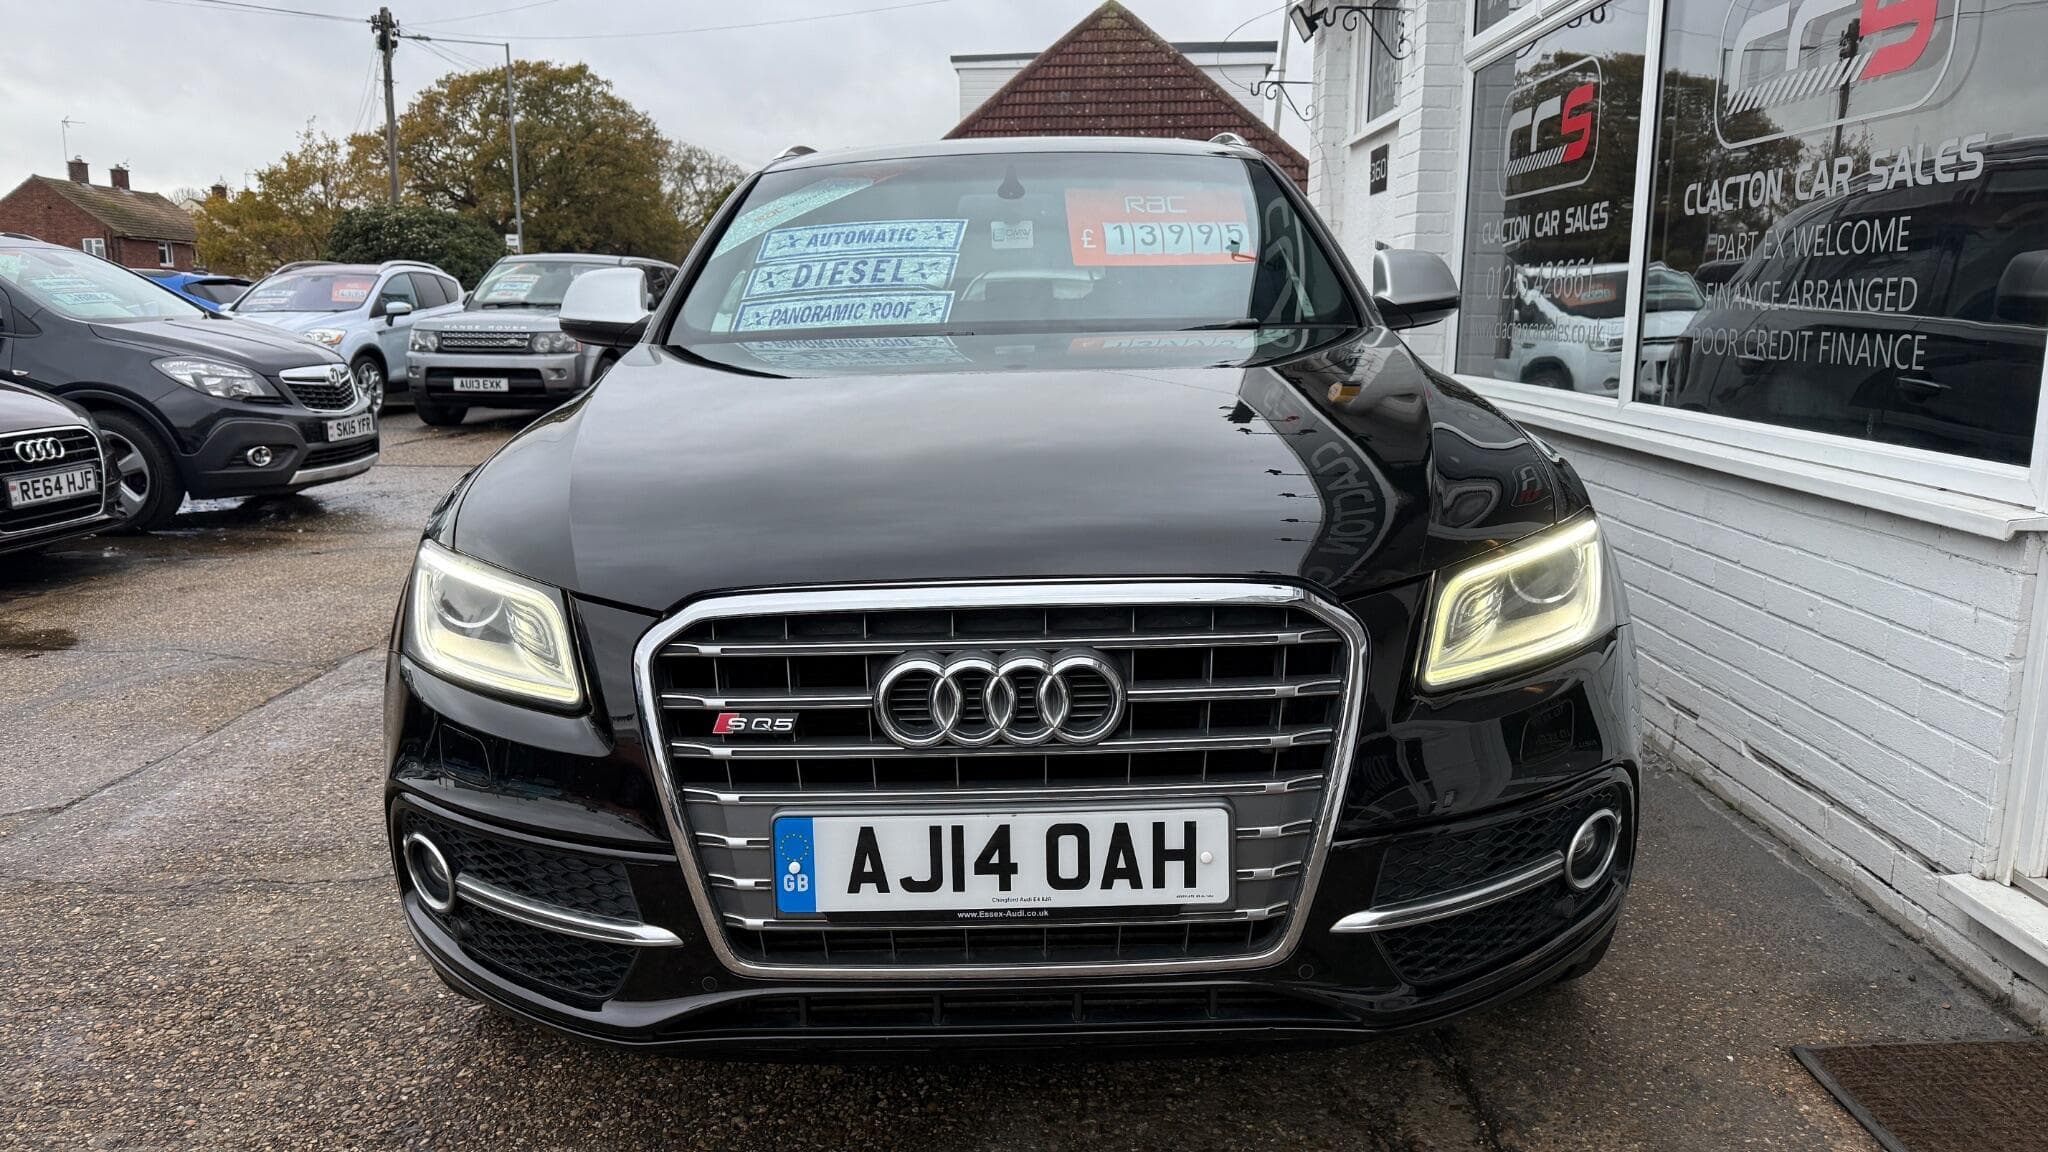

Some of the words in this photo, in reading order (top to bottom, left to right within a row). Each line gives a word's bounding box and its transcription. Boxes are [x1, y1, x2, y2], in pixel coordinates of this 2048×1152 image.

[1370, 157, 1387, 183] 360
[1684, 167, 1784, 216] CLACTON
[1795, 155, 1855, 201] CAR
[1867, 131, 1988, 193] SALES
[806, 227, 919, 248] AUTOMATIC
[1482, 215, 1531, 245] CLACTON
[1534, 209, 1560, 238] CAR
[1564, 201, 1610, 234] SALES
[1715, 230, 1759, 262] PART
[1763, 227, 1788, 260] EX
[1793, 215, 1912, 259] WELCOME
[791, 258, 908, 289] DIESEL
[1533, 256, 1595, 299] 426661
[1704, 280, 1782, 311] FINANCE
[1787, 276, 1919, 312] ARRANGED
[768, 303, 866, 327] PANORAMIC
[869, 301, 917, 320] ROOF
[1692, 327, 1739, 357] POOR
[1744, 328, 1813, 363] CREDIT
[1818, 331, 1928, 371] FINANCE
[459, 379, 481, 389] AU13
[482, 379, 502, 389] EXK
[336, 419, 356, 437] SK15
[357, 417, 371, 433] YFR
[19, 476, 63, 502] RE64
[66, 470, 92, 493] HJF
[847, 822, 1019, 895] AJ14
[1045, 820, 1198, 892] OAH
[783, 873, 809, 892] GB
[957, 909, 1049, 919] www.Essex-Audi.co.uk
